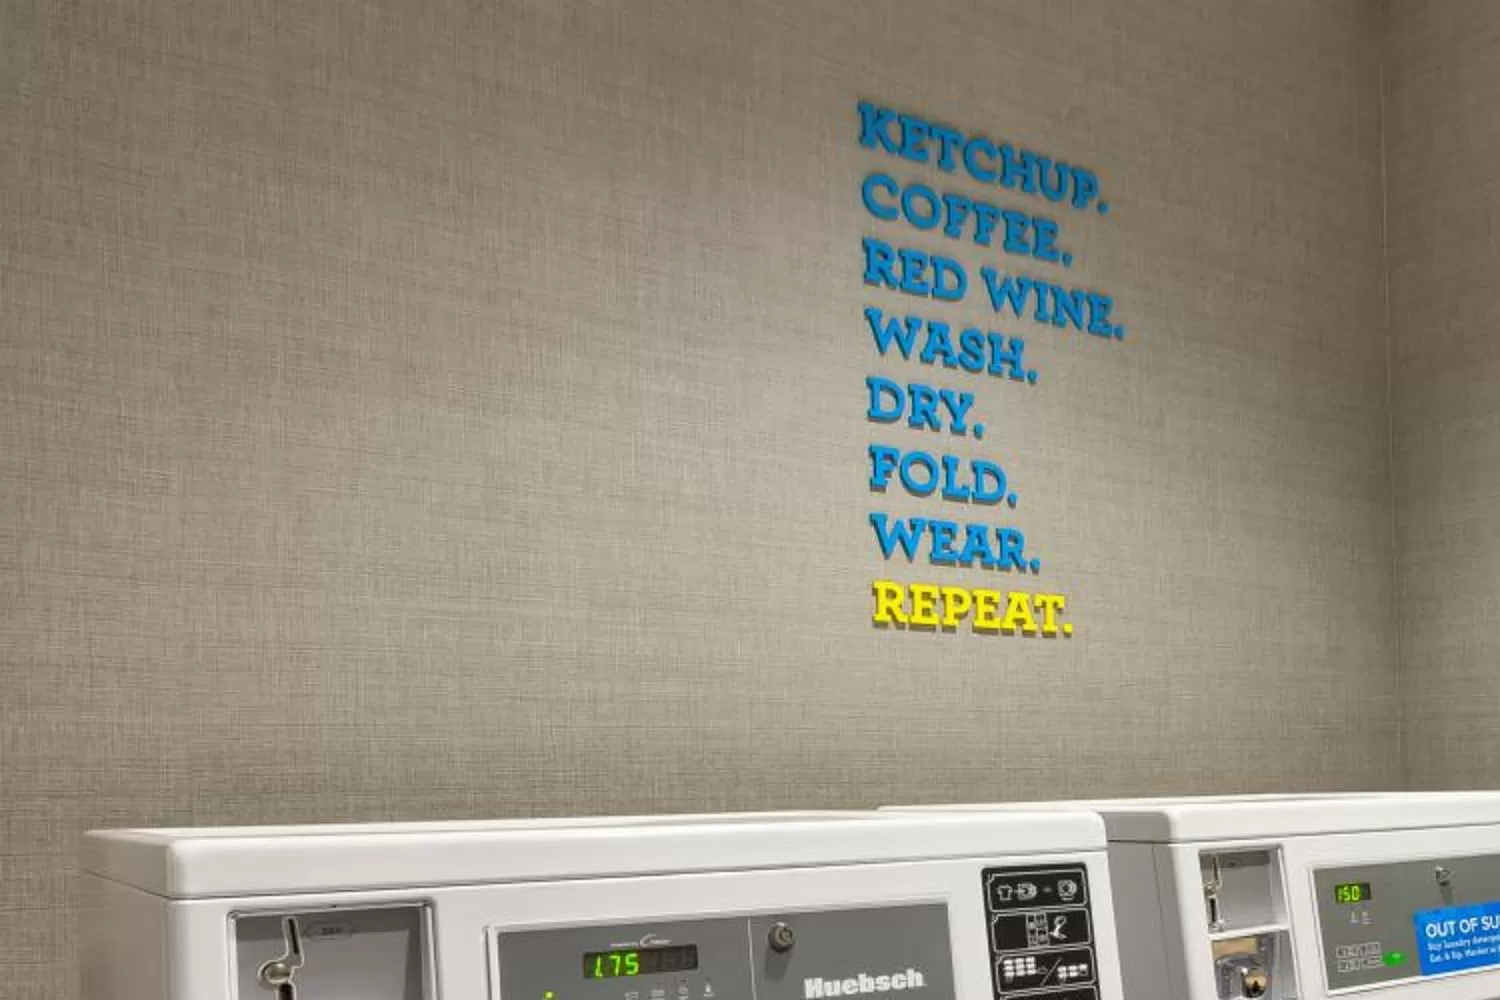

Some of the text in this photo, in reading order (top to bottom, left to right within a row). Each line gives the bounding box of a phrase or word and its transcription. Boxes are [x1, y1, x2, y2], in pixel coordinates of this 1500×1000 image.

[857, 101, 1109, 213] KETCHUP.
[861, 174, 1073, 266] COFFEE.
[862, 237, 1125, 339] RED WINE.
[865, 308, 1037, 380] WASH.
[866, 377, 984, 435] DRY.
[869, 445, 1017, 502] FOLD.
[870, 513, 1040, 568] WEAR.
[873, 580, 1072, 635] REPEAT.
[1425, 921, 1456, 938] OUT
[1459, 918, 1478, 933] OF
[804, 968, 924, 1000] Huebsch
